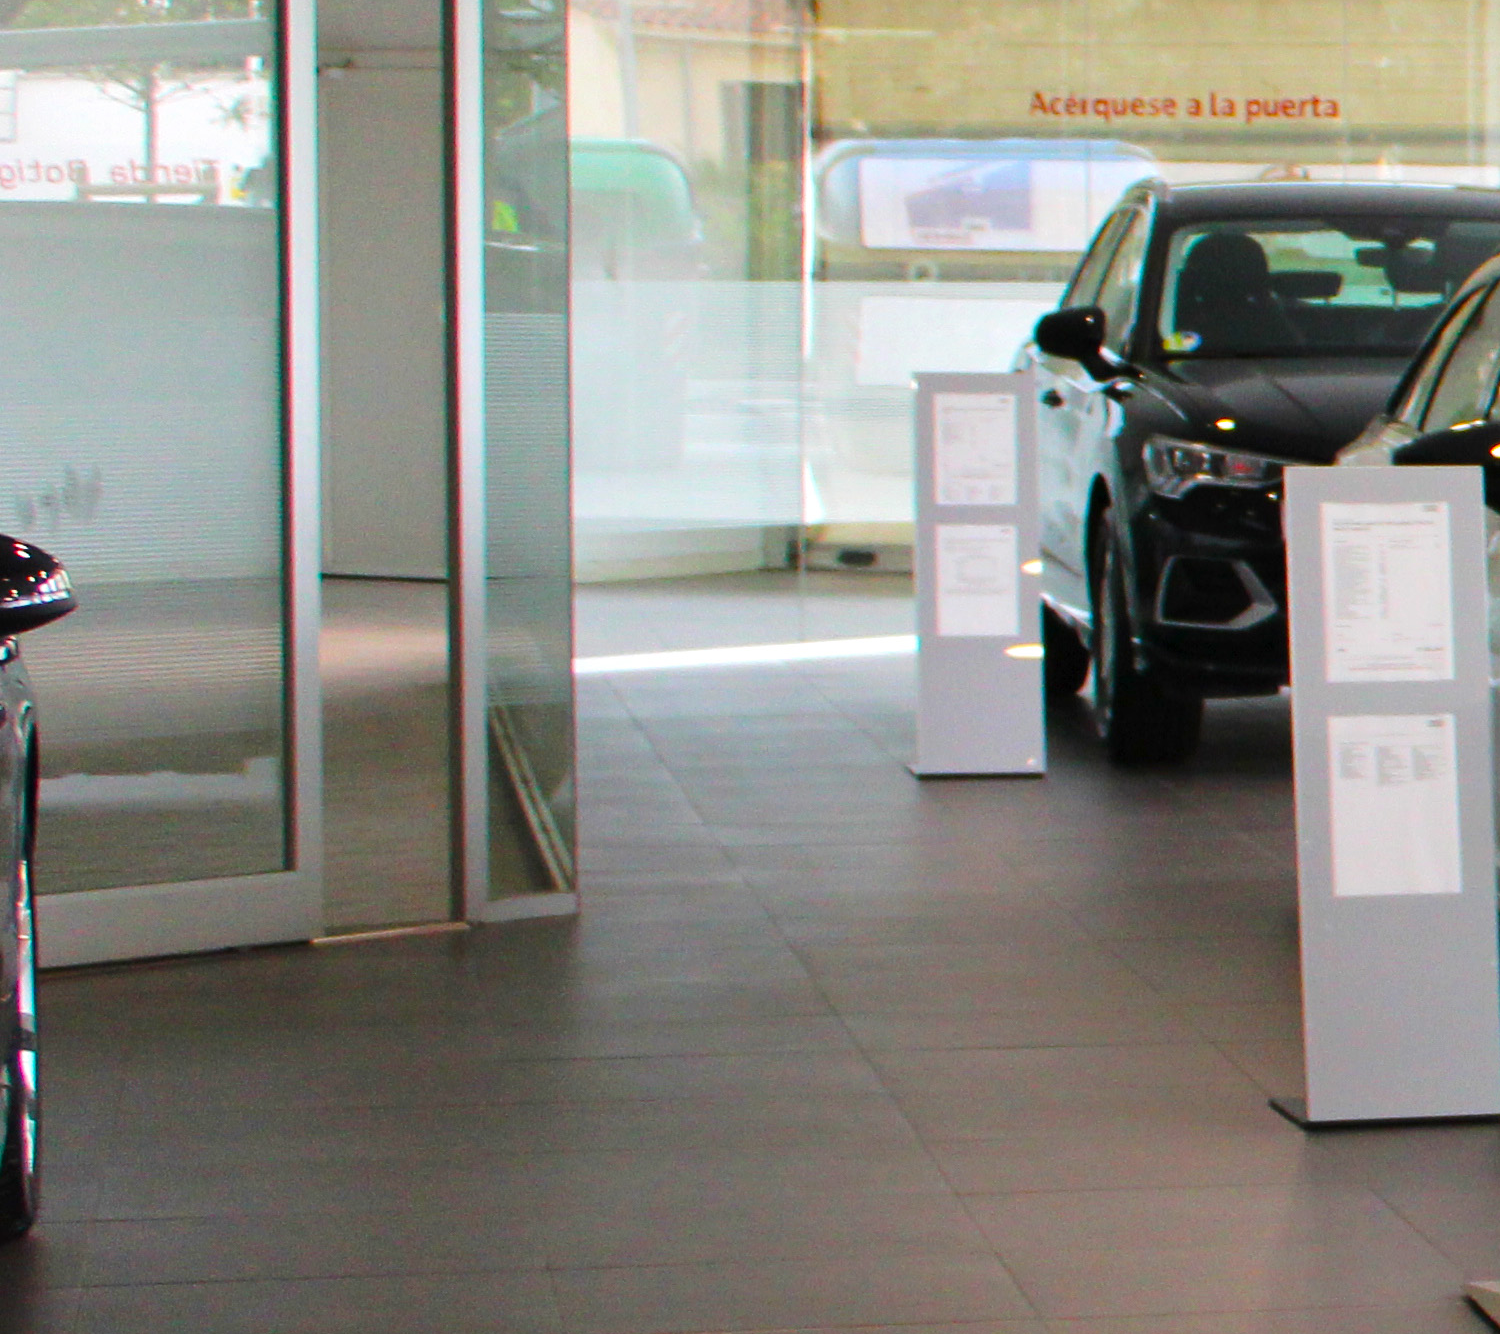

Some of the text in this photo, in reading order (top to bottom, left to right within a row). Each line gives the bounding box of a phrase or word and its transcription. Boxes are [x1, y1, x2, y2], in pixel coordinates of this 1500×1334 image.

[1028, 90, 1341, 124] Acérquese a la puerta
